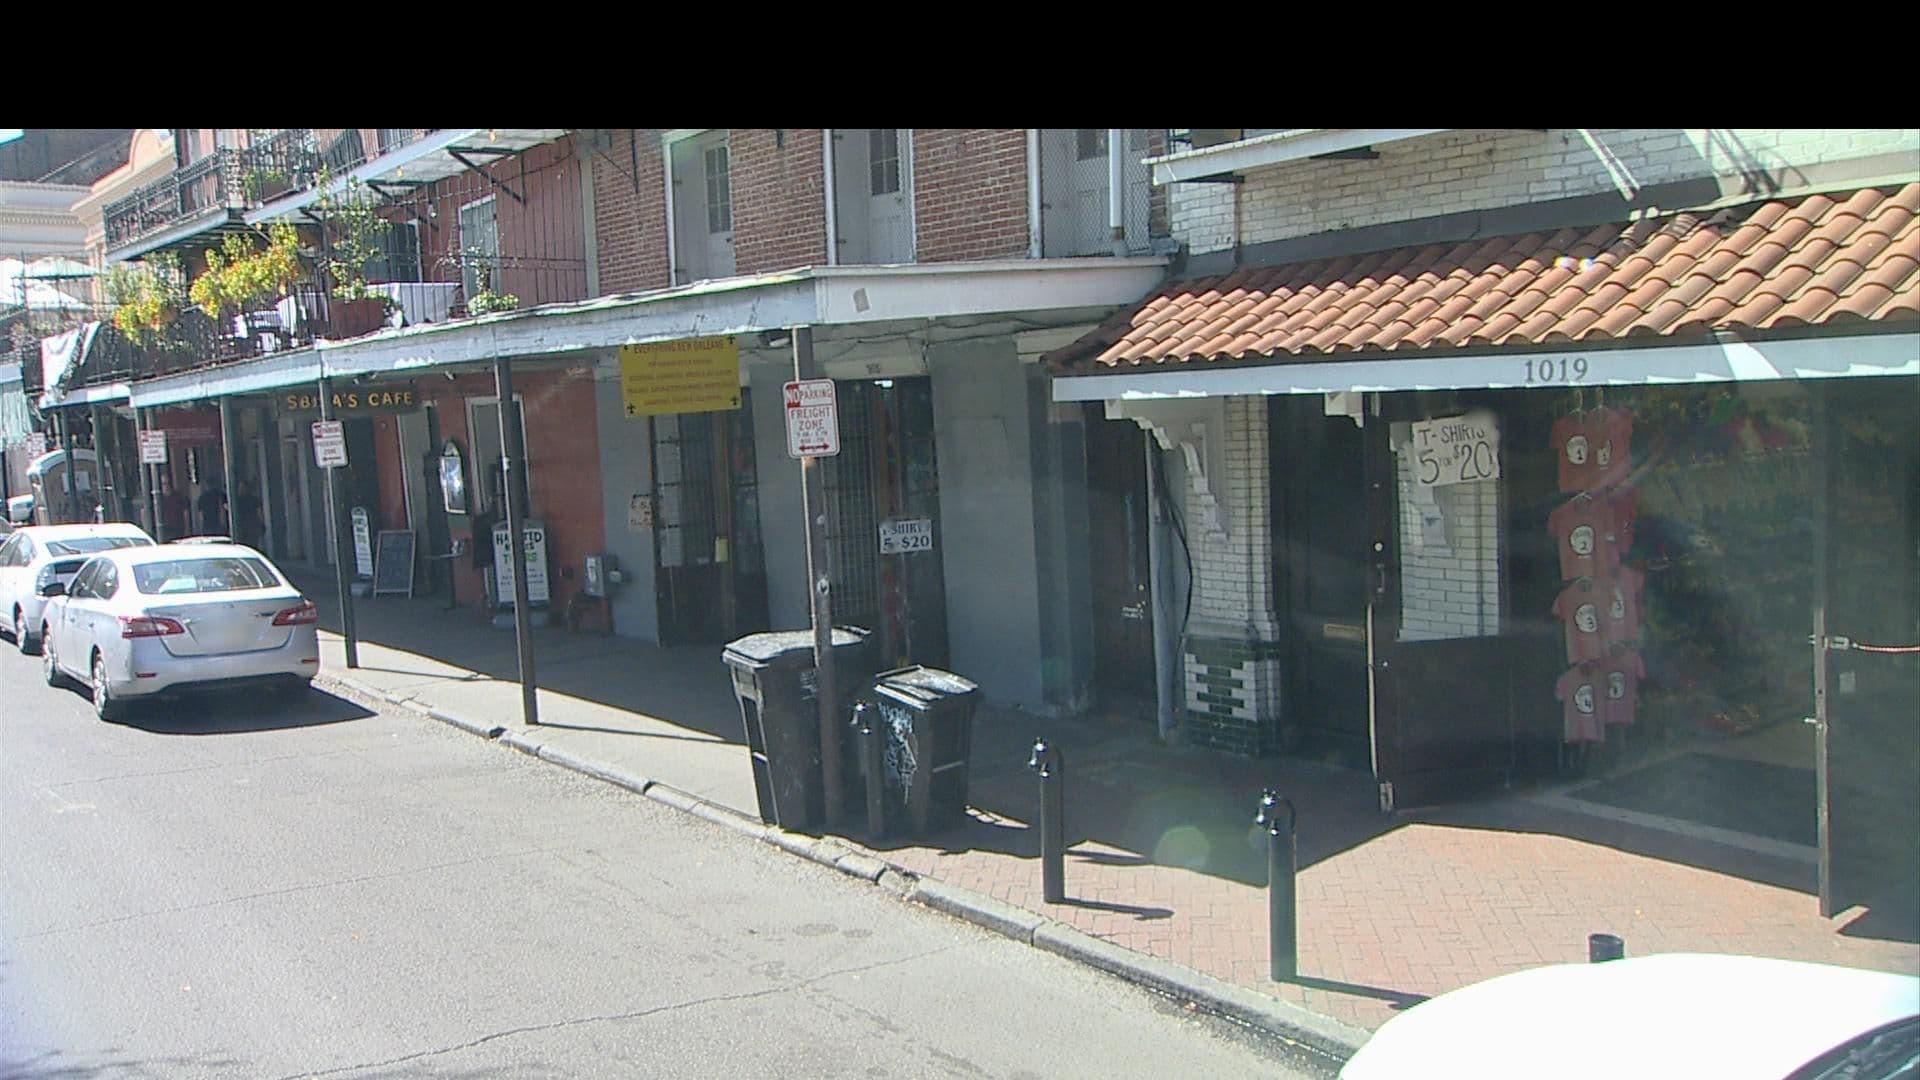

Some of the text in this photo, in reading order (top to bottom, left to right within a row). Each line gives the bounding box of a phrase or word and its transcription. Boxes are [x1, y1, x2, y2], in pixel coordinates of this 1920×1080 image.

[1525, 357, 1589, 383] 1019
[287, 391, 413, 410] SBIA'S CAFE
[786, 388, 833, 404] NO PARKING
[790, 407, 831, 420] FREIGHT
[798, 418, 825, 432] ZONE
[1419, 448, 1440, 484] 5
[1453, 440, 1493, 481] $20
[496, 532, 543, 546] HATED
[901, 535, 930, 550] $20
